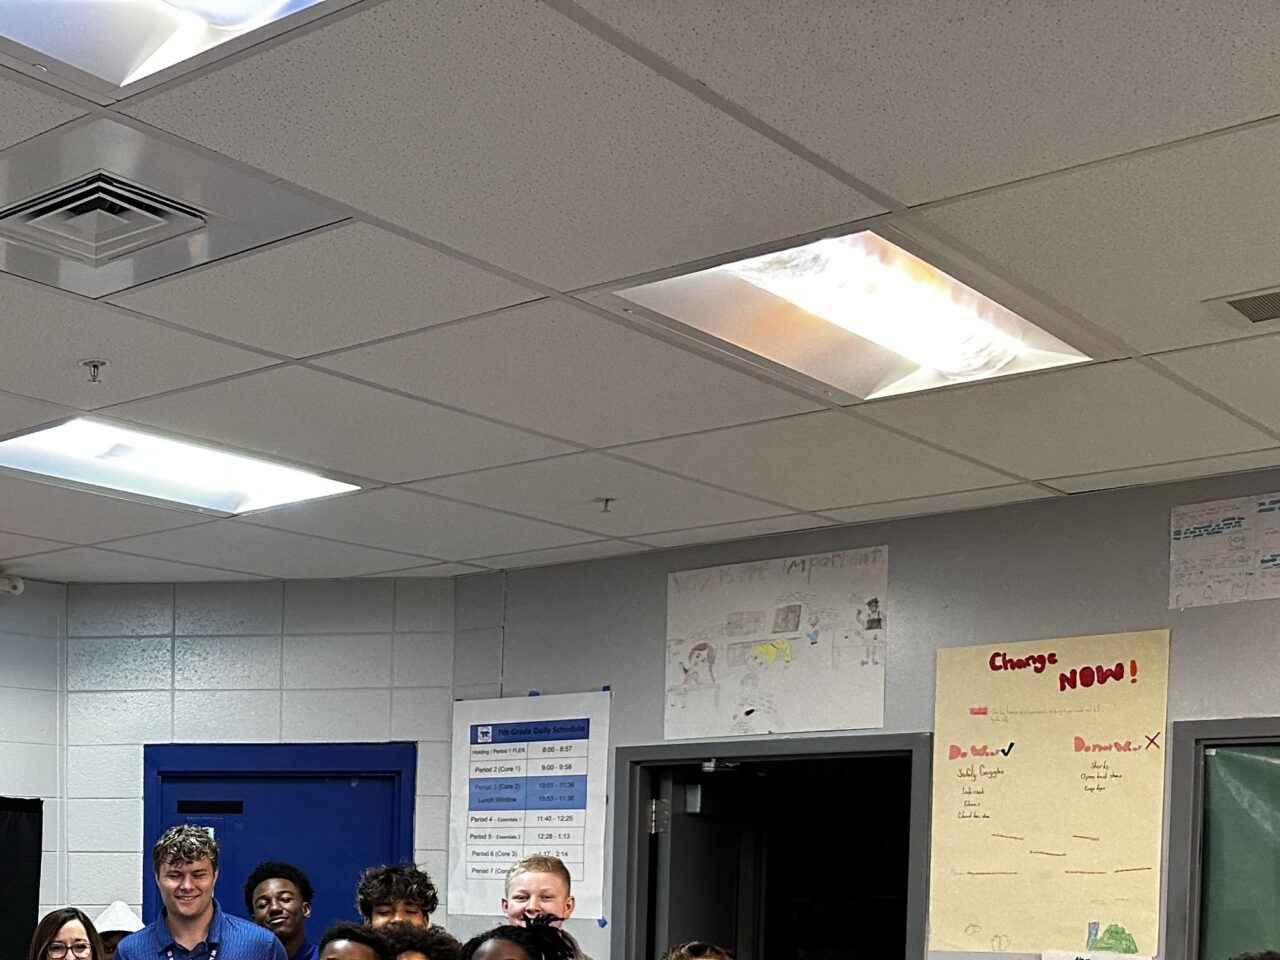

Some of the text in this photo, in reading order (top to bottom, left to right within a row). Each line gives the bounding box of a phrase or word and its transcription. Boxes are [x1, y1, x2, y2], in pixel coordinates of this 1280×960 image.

[989, 651, 1058, 674] Change
[511, 727, 531, 736] Grade
[533, 726, 551, 735] Daily
[552, 724, 585, 734] Schedule
[495, 850, 511, 858] (Core
